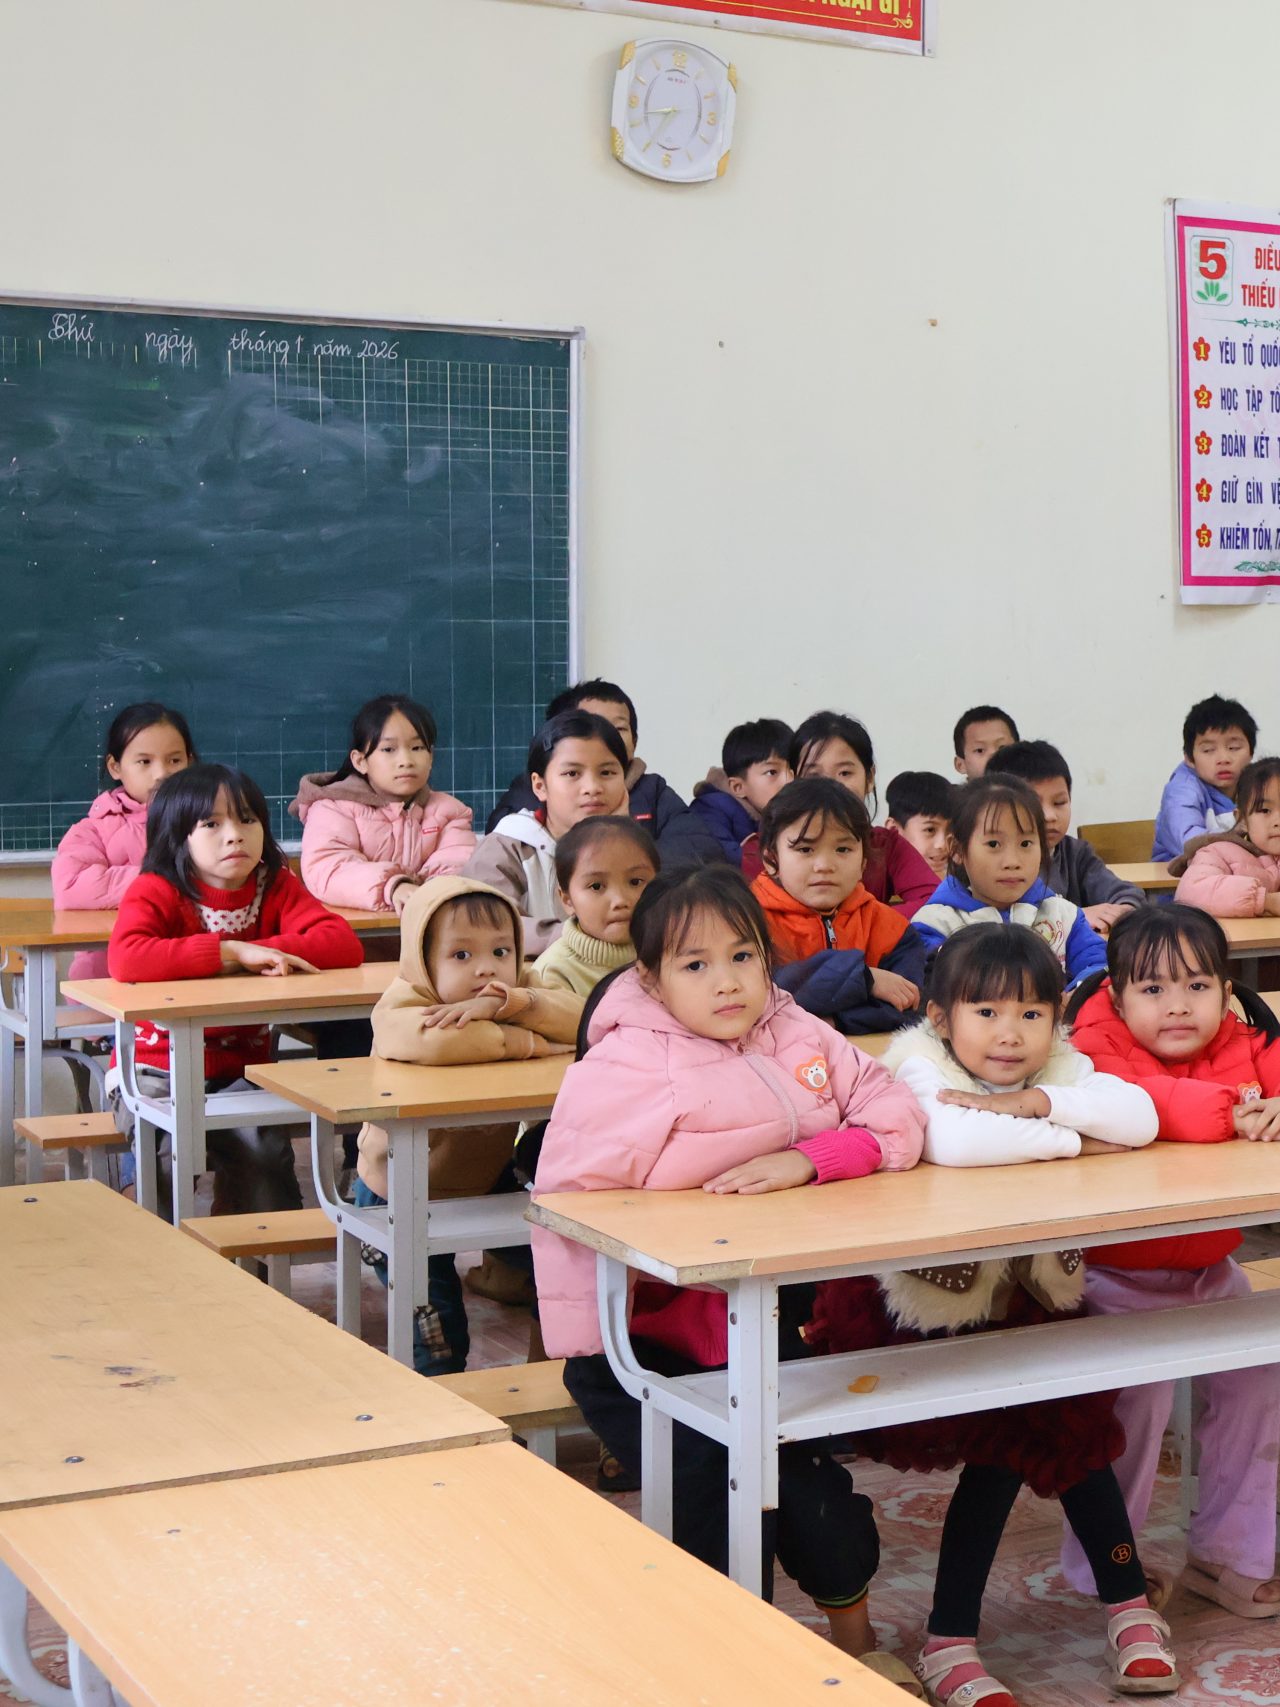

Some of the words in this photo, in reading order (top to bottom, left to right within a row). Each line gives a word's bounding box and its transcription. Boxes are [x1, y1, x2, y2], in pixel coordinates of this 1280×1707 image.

[1198, 240, 1228, 280] 5
[1241, 278, 1275, 308] THIẾU
[145, 328, 193, 364] ngày
[229, 328, 289, 367] tháng
[314, 339, 352, 357] năm
[357, 339, 400, 360] 2026
[1199, 343, 1206, 358] 1
[1219, 337, 1236, 365] YÊU
[1242, 334, 1254, 366] TỔ
[1199, 391, 1208, 404] 2
[1220, 387, 1239, 416] HỌC
[1245, 384, 1263, 417] TẬP
[1199, 436, 1208, 451] 3
[1221, 429, 1246, 458] ĐOÀN
[1253, 428, 1270, 459] KẾT
[1199, 484, 1208, 498] 4
[1221, 475, 1239, 504] GIỮ
[1246, 476, 1263, 504] GÌN
[1199, 530, 1208, 544] 5
[1219, 522, 1250, 550] KHIÊM
